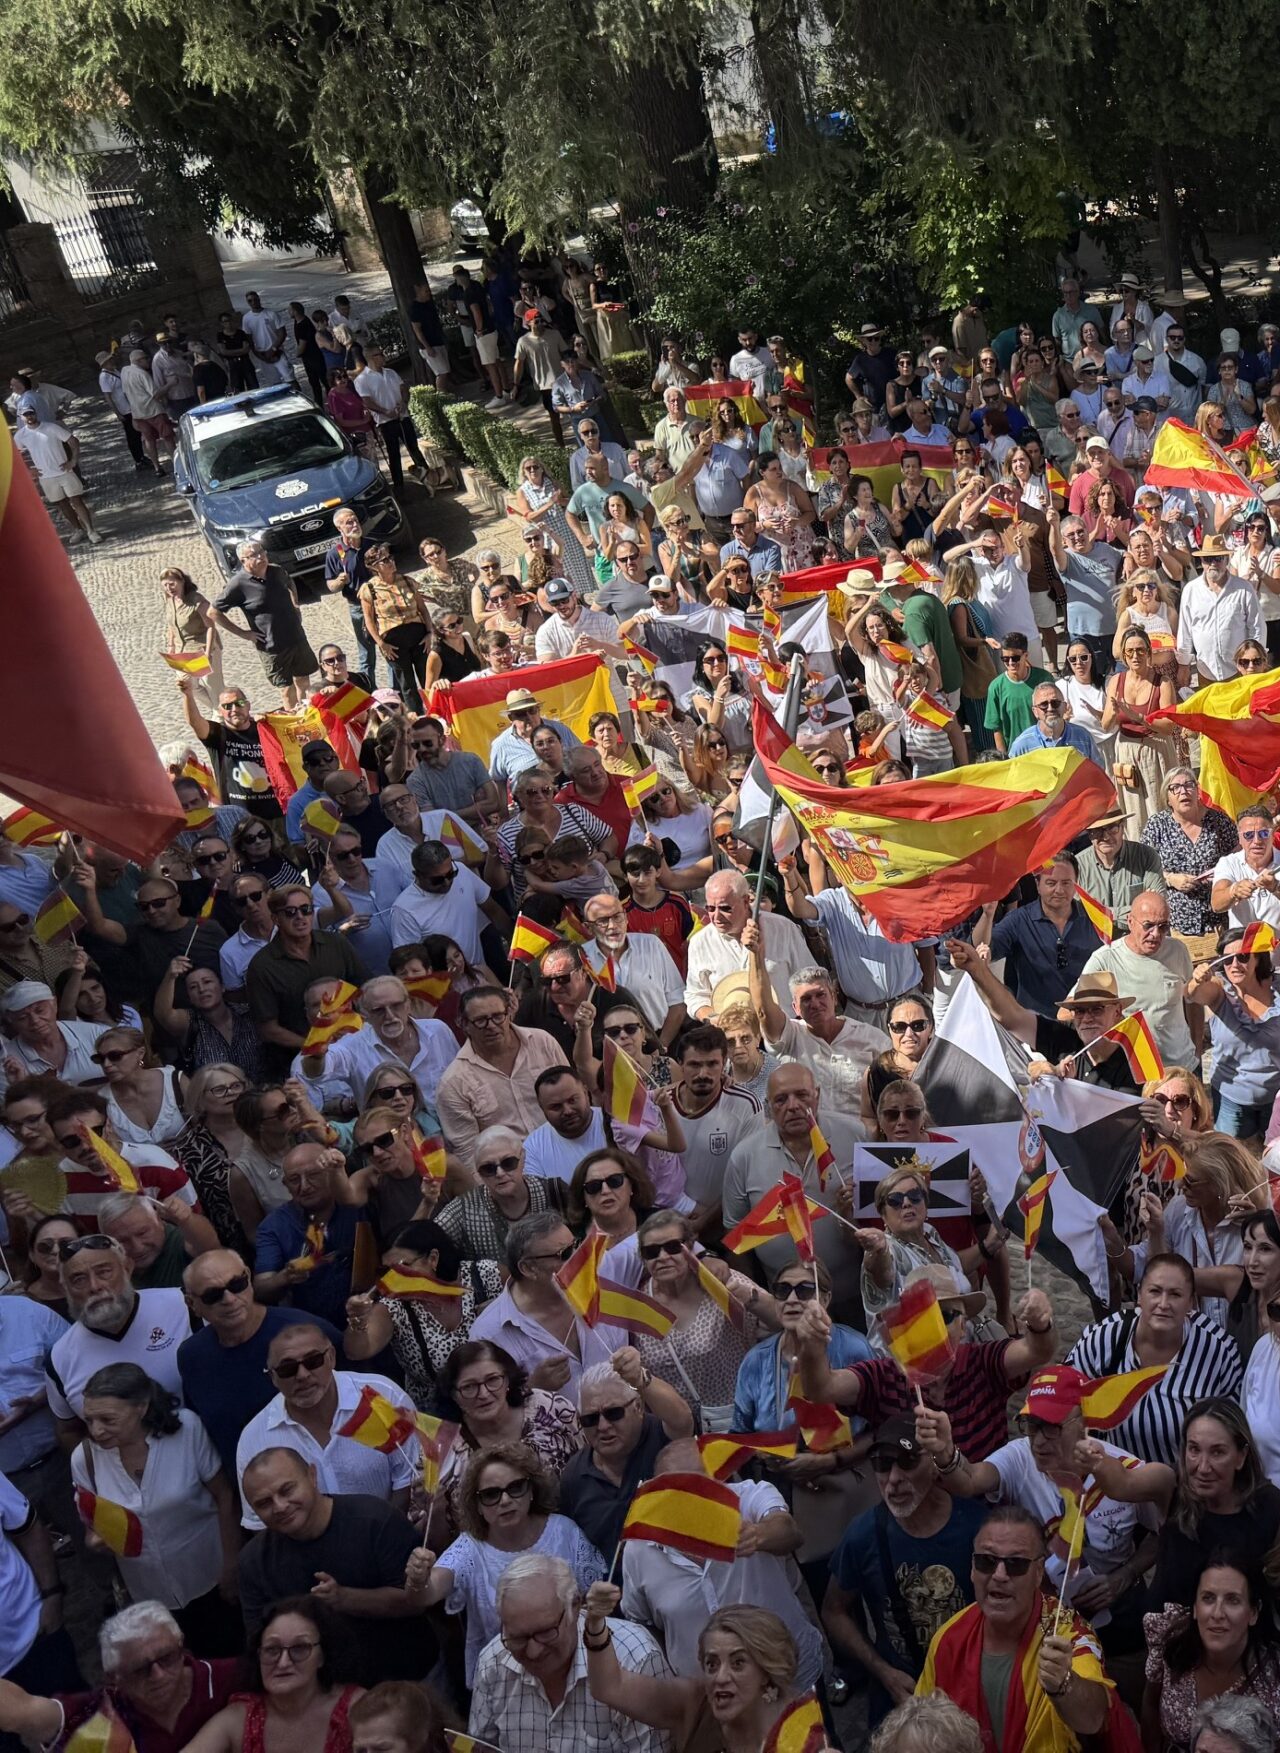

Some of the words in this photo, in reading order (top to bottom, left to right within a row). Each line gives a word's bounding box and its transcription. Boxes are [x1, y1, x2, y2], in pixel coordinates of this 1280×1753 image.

[268, 502, 328, 525] POLICIA
[300, 538, 340, 557] CNP2395
[1030, 1385, 1056, 1396] ESPAÑA
